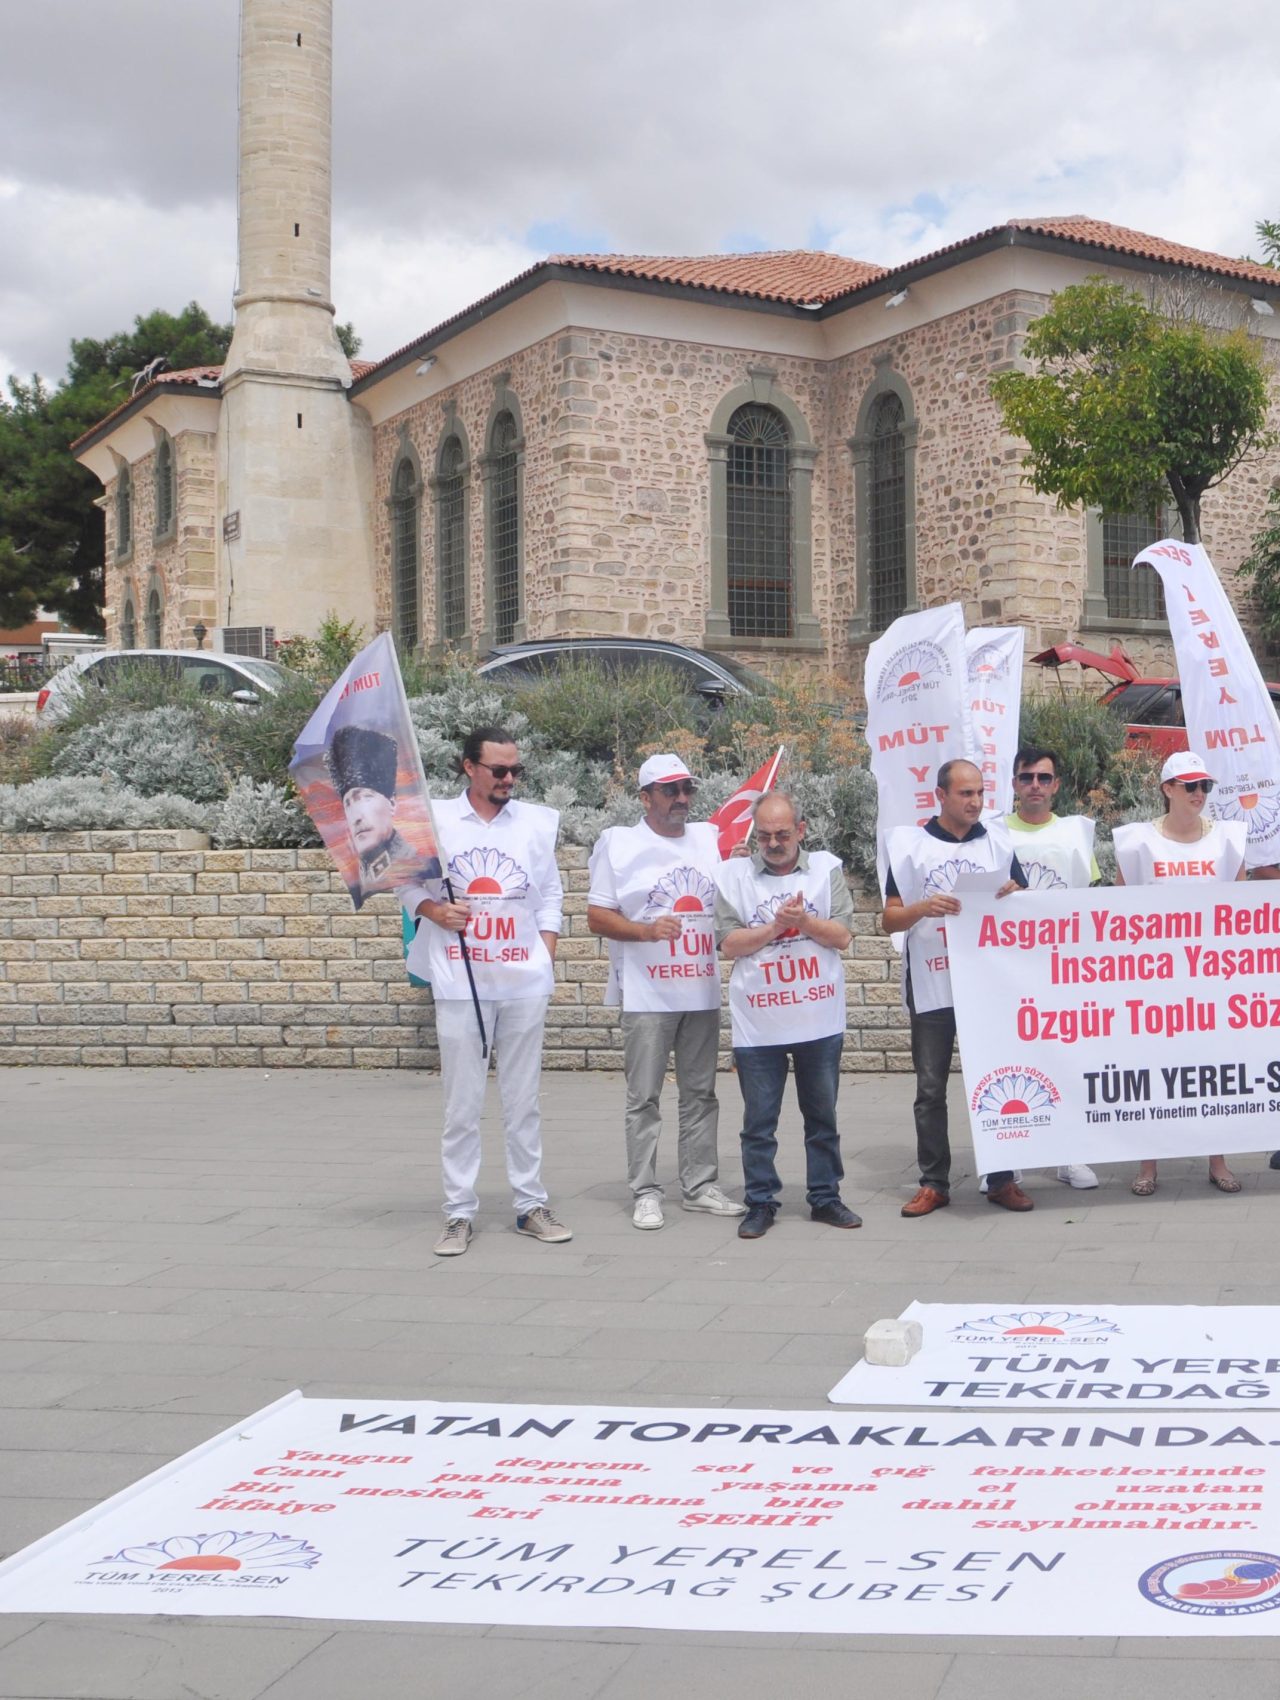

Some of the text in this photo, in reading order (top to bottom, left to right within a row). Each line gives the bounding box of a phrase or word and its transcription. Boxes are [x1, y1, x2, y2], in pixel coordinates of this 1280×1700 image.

[1204, 724, 1266, 752] TÜM
[1154, 861, 1216, 878] EMEK
[978, 911, 1080, 950] Asgari
[1091, 906, 1202, 945] Yaşamı
[759, 955, 820, 985] TÜM
[1050, 945, 1174, 984] İnsanca
[746, 984, 835, 1008] YEREL-SEN
[1017, 998, 1114, 1044] Özgür
[1125, 996, 1216, 1038] Toplu
[993, 1066, 1022, 1077] TOPLU
[1083, 1064, 1150, 1104] TÜM
[982, 1119, 999, 1128] TÜM
[1001, 1114, 1051, 1126] YEREL-SEN
[1085, 1110, 1111, 1124] Tüm
[1114, 1109, 1146, 1122] Yerel
[1149, 1105, 1197, 1120] Yönetim
[1201, 1101, 1265, 1118] Çalışanları
[996, 1130, 1030, 1140] OLMAZ
[967, 1353, 1111, 1374] TÜM
[923, 1379, 1271, 1400] TEKİRDAĞ
[339, 1413, 575, 1438] VATAN
[278, 1450, 414, 1465] Yangın
[495, 1457, 652, 1472] deprem,
[691, 1463, 755, 1474] sel
[791, 1465, 834, 1475] ve
[870, 1464, 936, 1478] çığ
[970, 1465, 1266, 1477] felaketlerinde
[253, 1466, 1265, 1494] Canı pahasına yaşama el uzatan
[223, 1481, 1262, 1515] Bir meslek sınıfına bile dahil olmayan
[196, 1495, 1259, 1533] İtfaiye Eri ŞEHİT sayılmalıdır.
[393, 1536, 1066, 1572] TÜM YEREL-SEN
[84, 1571, 290, 1585] TÜM YEREL-SEN
[397, 1571, 1014, 1603] TEKİRDAĞ ŞUBESİ
[1154, 1594, 1217, 1615] BİRLEŞİK
